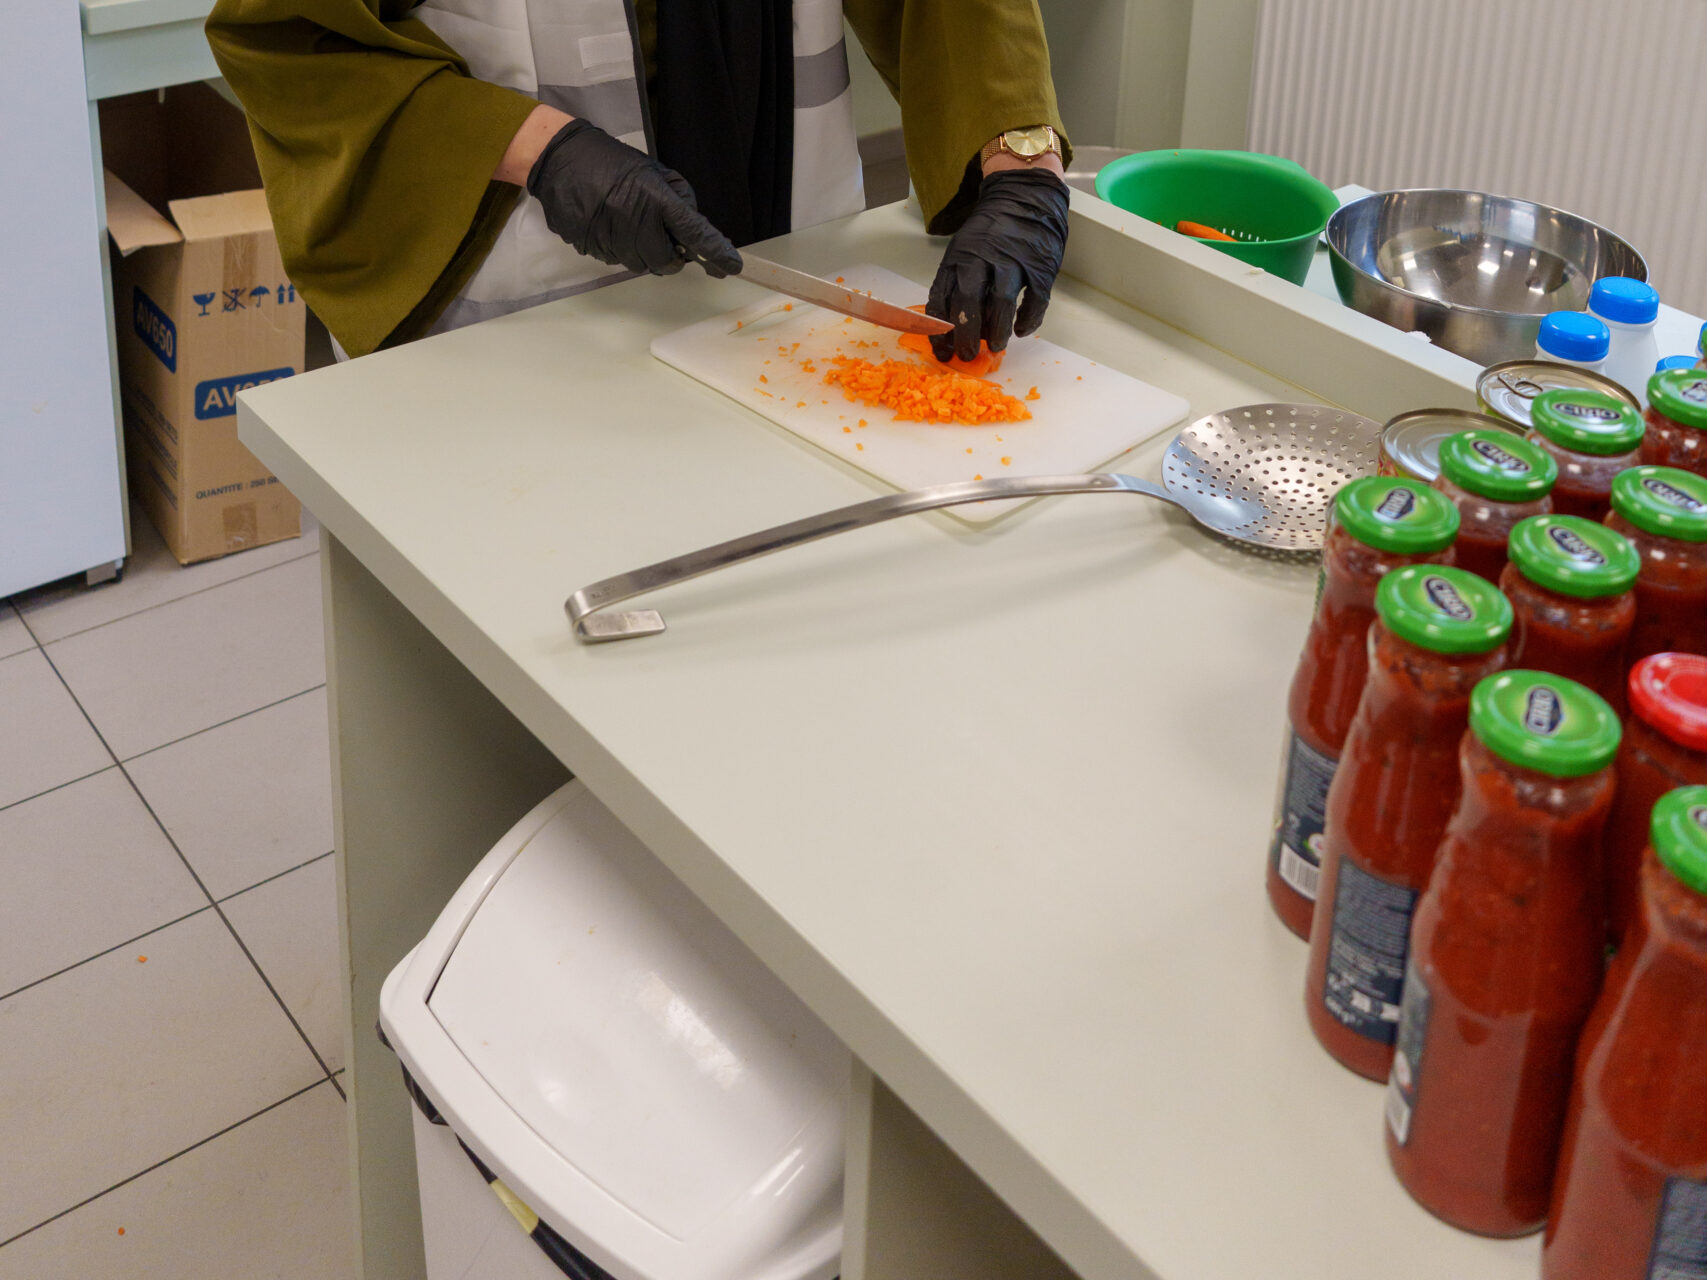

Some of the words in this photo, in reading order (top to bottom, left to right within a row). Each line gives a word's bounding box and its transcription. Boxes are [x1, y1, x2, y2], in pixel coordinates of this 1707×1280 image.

[137, 301, 173, 358] AV650
[195, 482, 243, 499] QUANTITE
[1429, 579, 1470, 619] CIRIO
[1527, 689, 1554, 733] CIRIO
